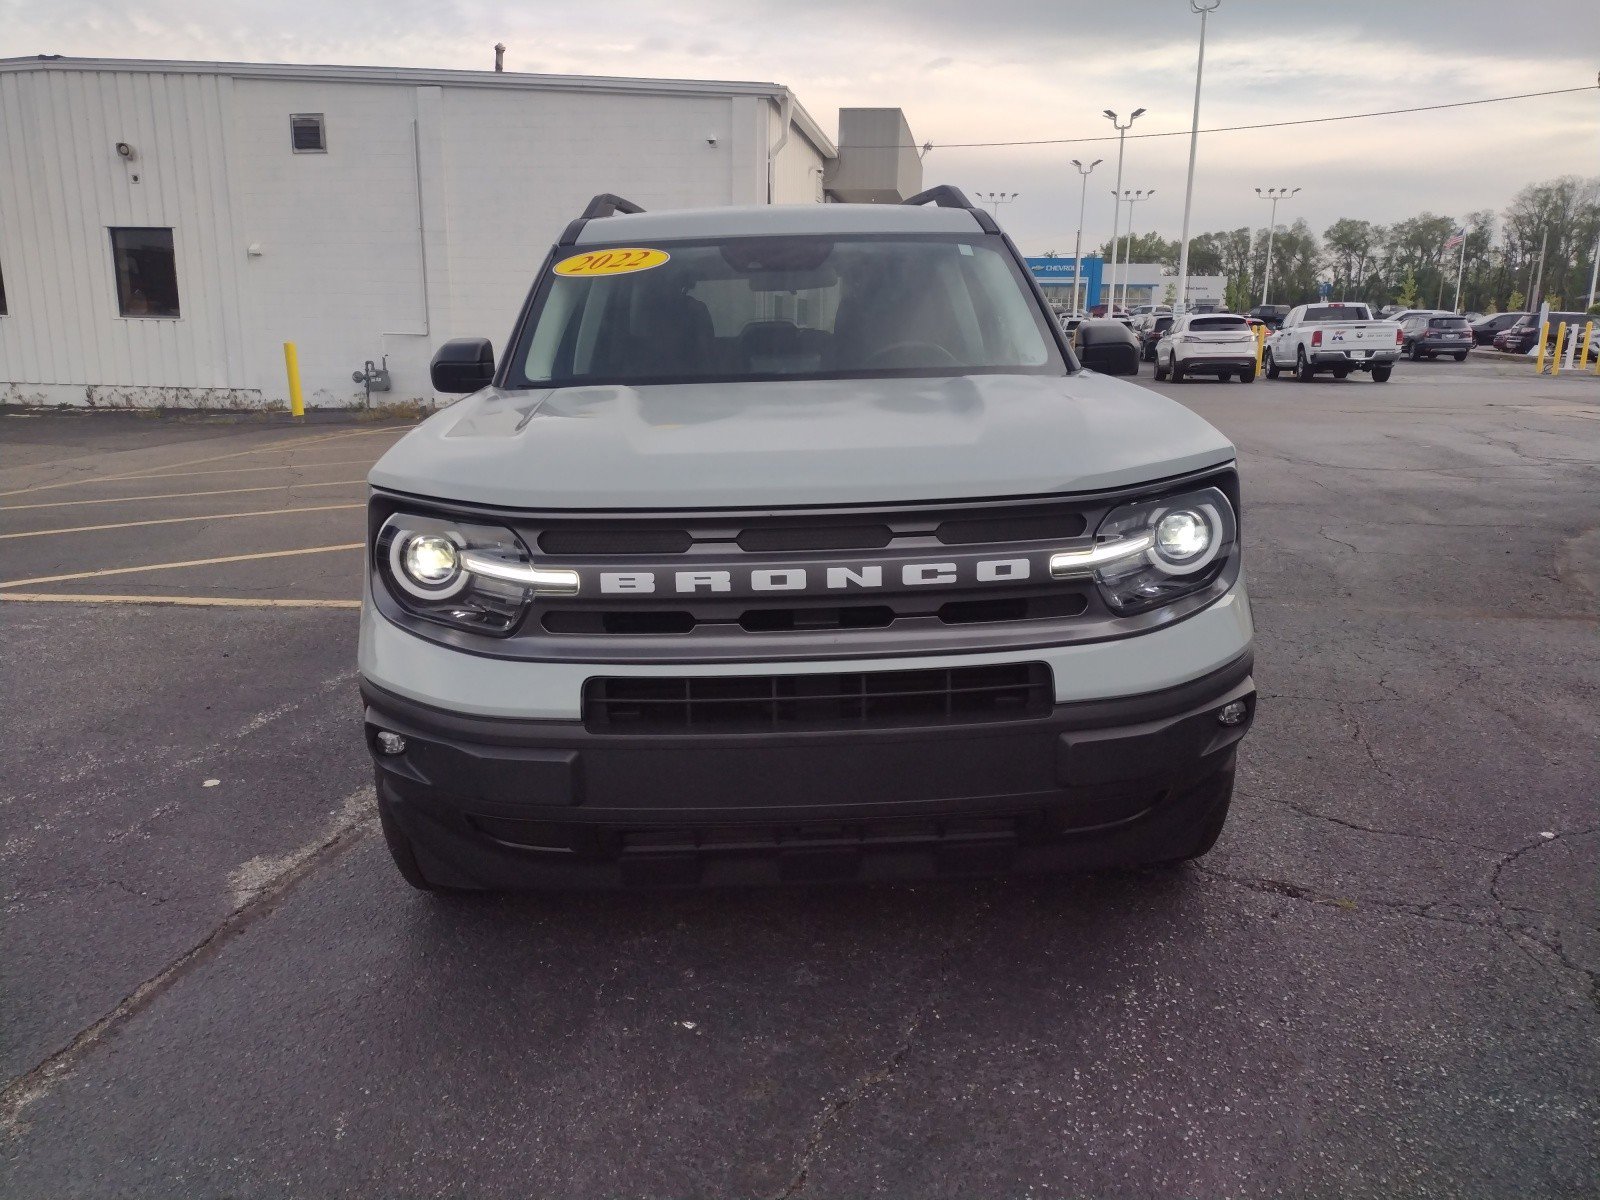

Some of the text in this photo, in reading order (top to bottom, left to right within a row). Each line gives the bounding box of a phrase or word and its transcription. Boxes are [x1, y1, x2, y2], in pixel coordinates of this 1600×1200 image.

[568, 251, 651, 272] 2022
[1045, 264, 1084, 272] CHEVROLT
[600, 558, 1030, 593] BRONCO
